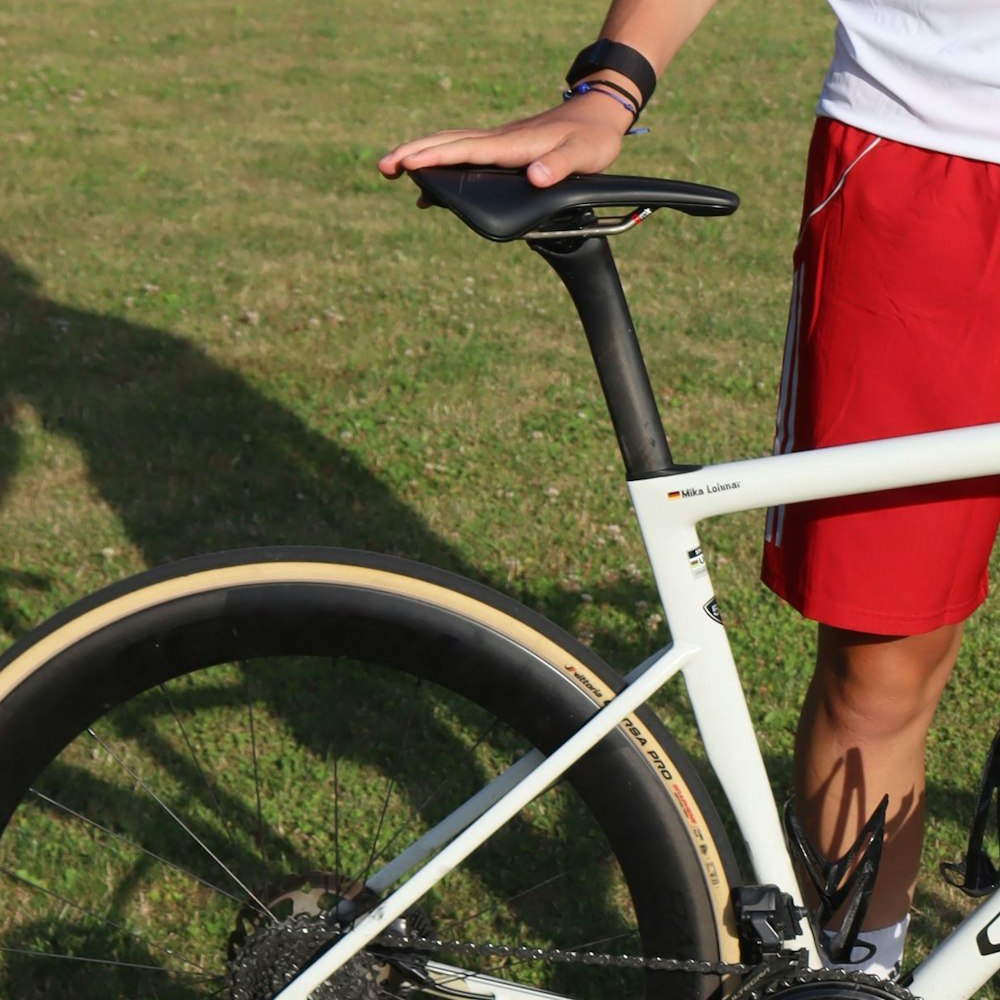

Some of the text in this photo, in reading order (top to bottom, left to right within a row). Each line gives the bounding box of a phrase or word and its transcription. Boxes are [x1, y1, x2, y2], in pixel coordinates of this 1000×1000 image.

[681, 488, 704, 498] Mika
[573, 672, 602, 698] vittoria
[647, 750, 672, 781] PRO
